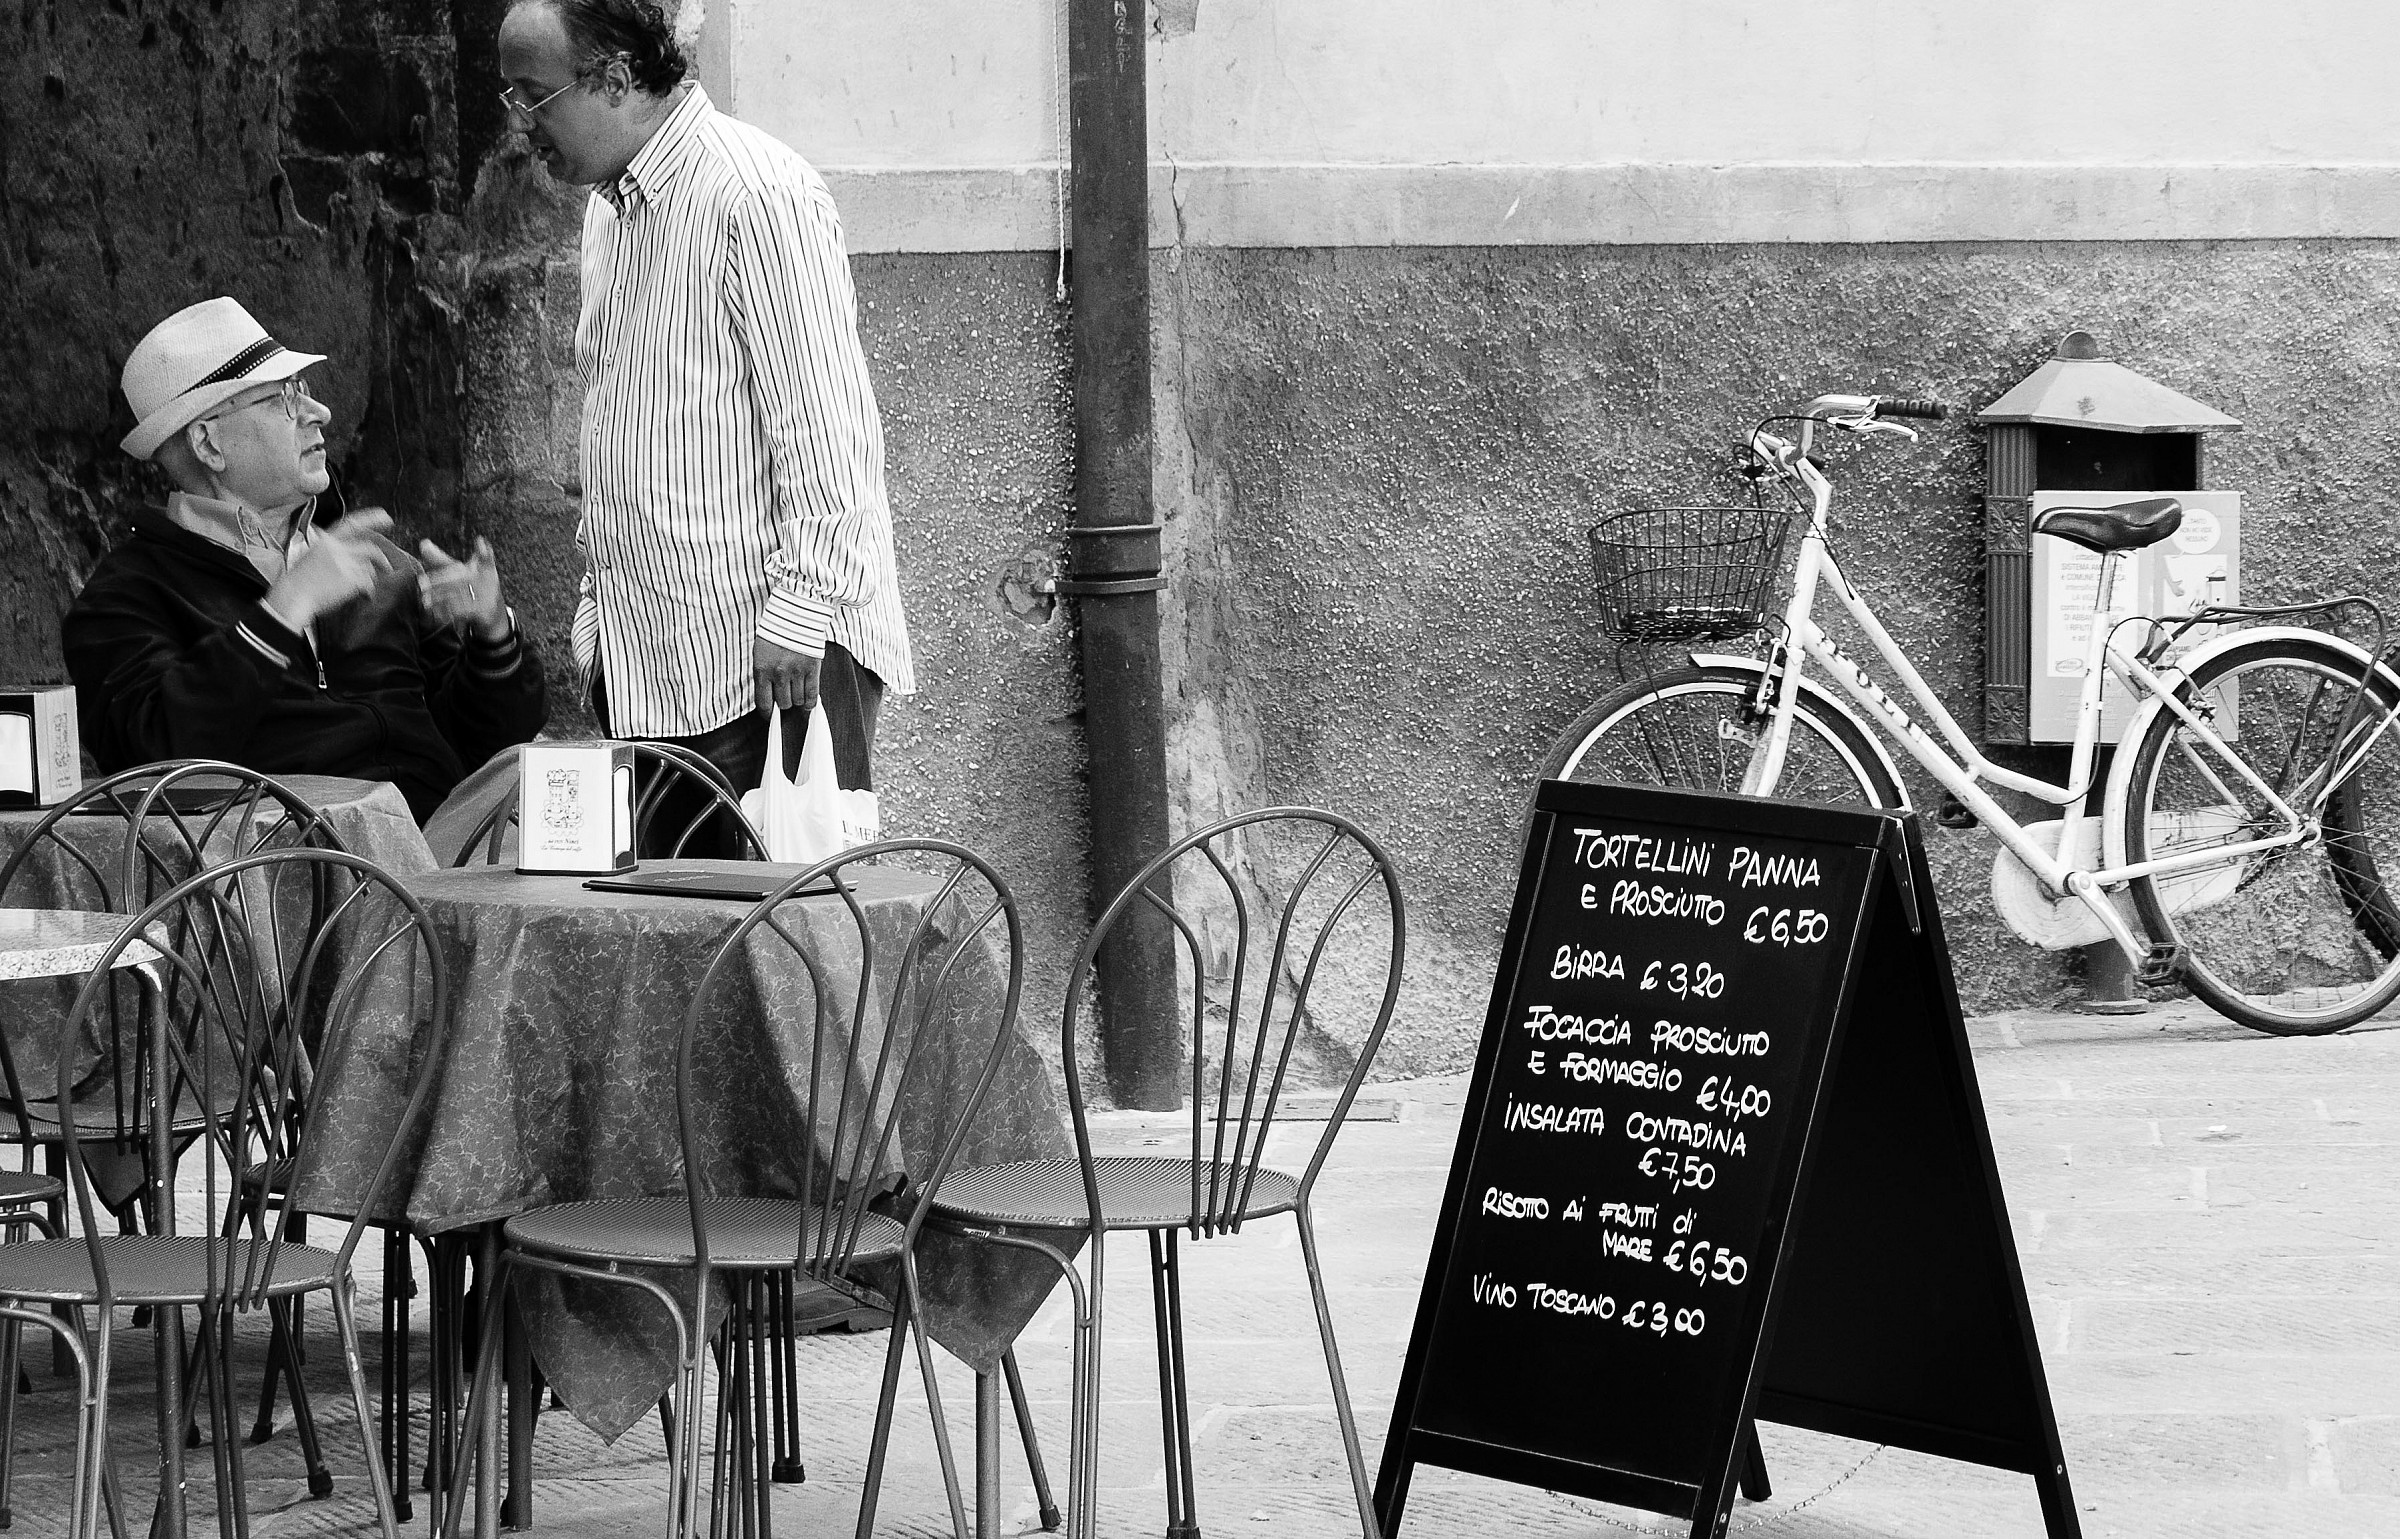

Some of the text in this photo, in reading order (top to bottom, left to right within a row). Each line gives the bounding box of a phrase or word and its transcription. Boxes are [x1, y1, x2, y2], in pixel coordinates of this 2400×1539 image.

[1728, 847, 1820, 888] PANNA
[1581, 884, 1597, 908] E
[1528, 1050, 1545, 1074] E
[1603, 1229, 1652, 1262] MARE
[1527, 1283, 1615, 1319] TOSCANO
